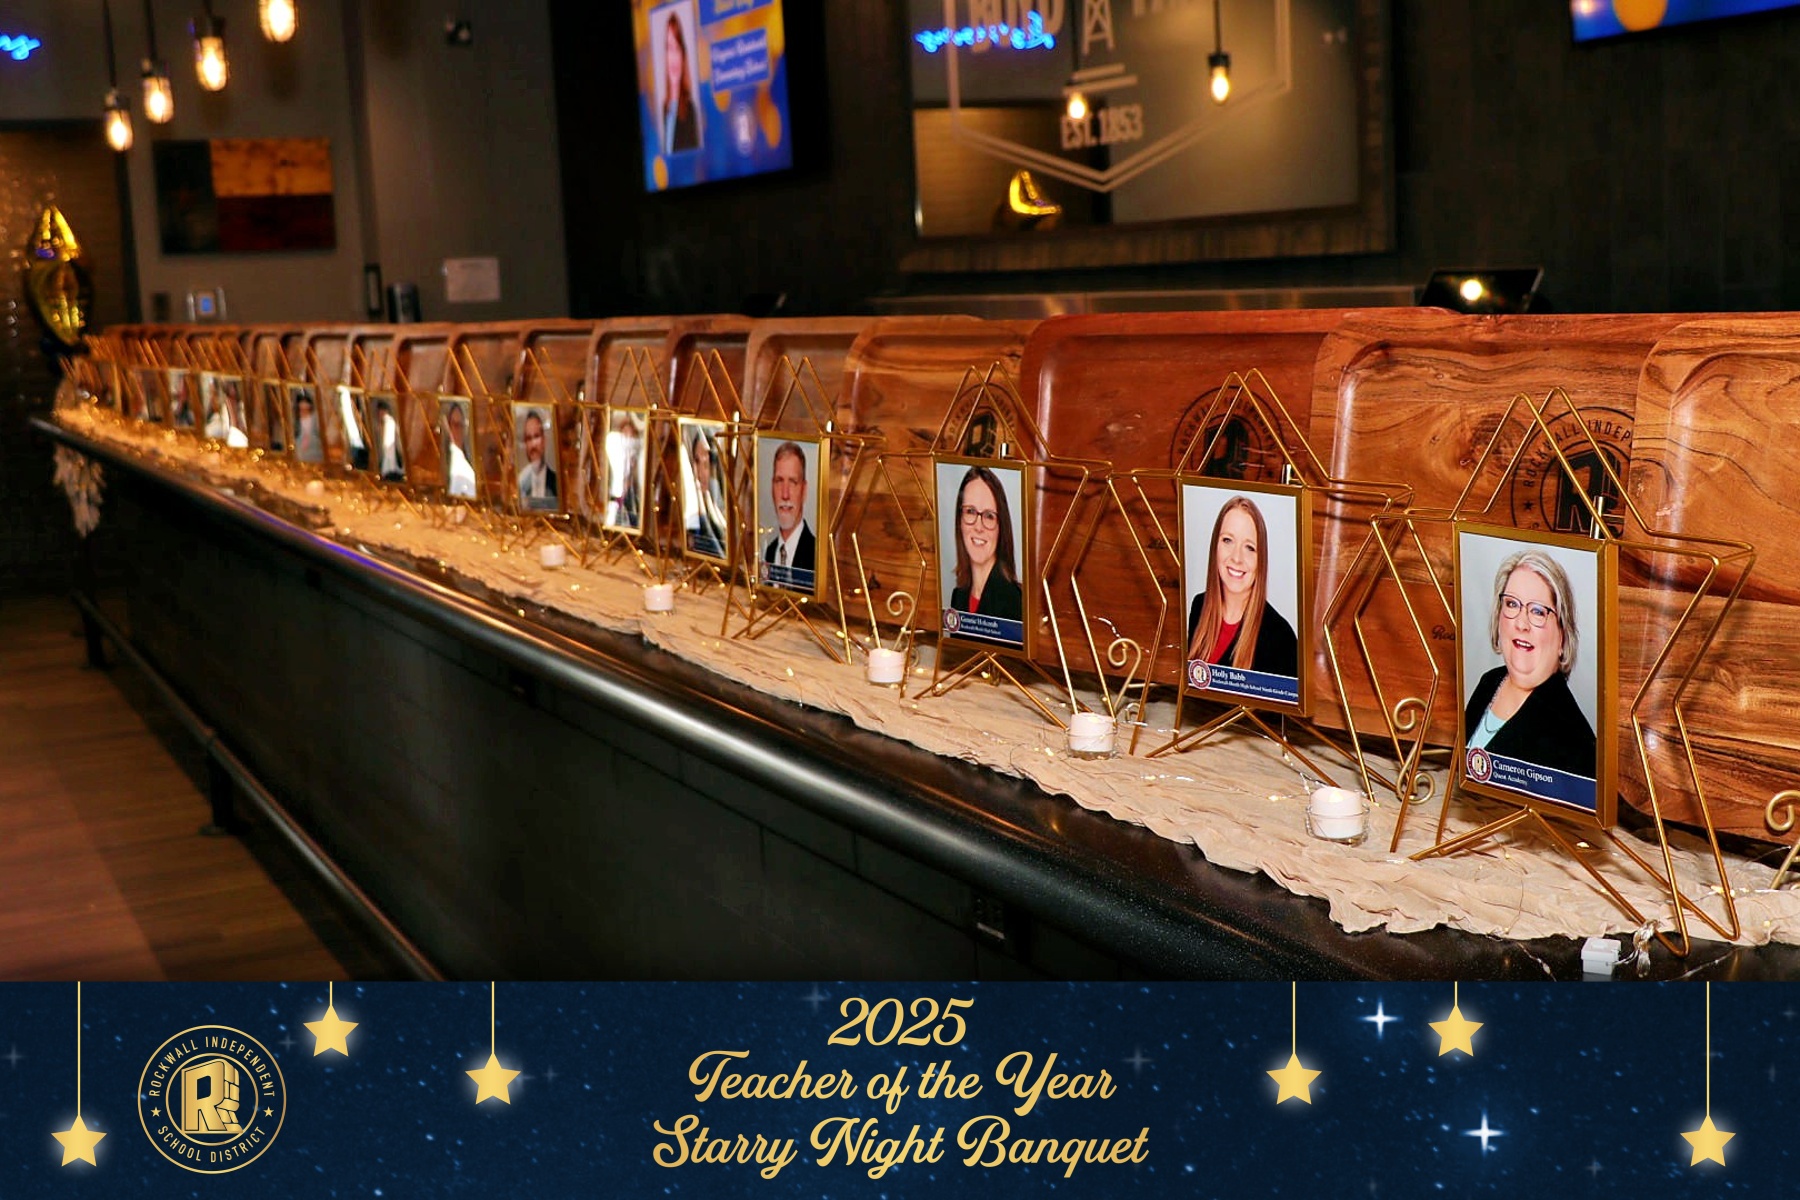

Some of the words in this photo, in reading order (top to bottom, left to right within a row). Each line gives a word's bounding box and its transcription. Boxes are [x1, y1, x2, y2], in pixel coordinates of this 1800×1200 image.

[1588, 419, 1633, 448] INDEP
[1211, 669, 1228, 680] Holly
[1229, 671, 1246, 682] Babb
[1492, 759, 1525, 776] Cameron
[1526, 768, 1553, 783] Gipson
